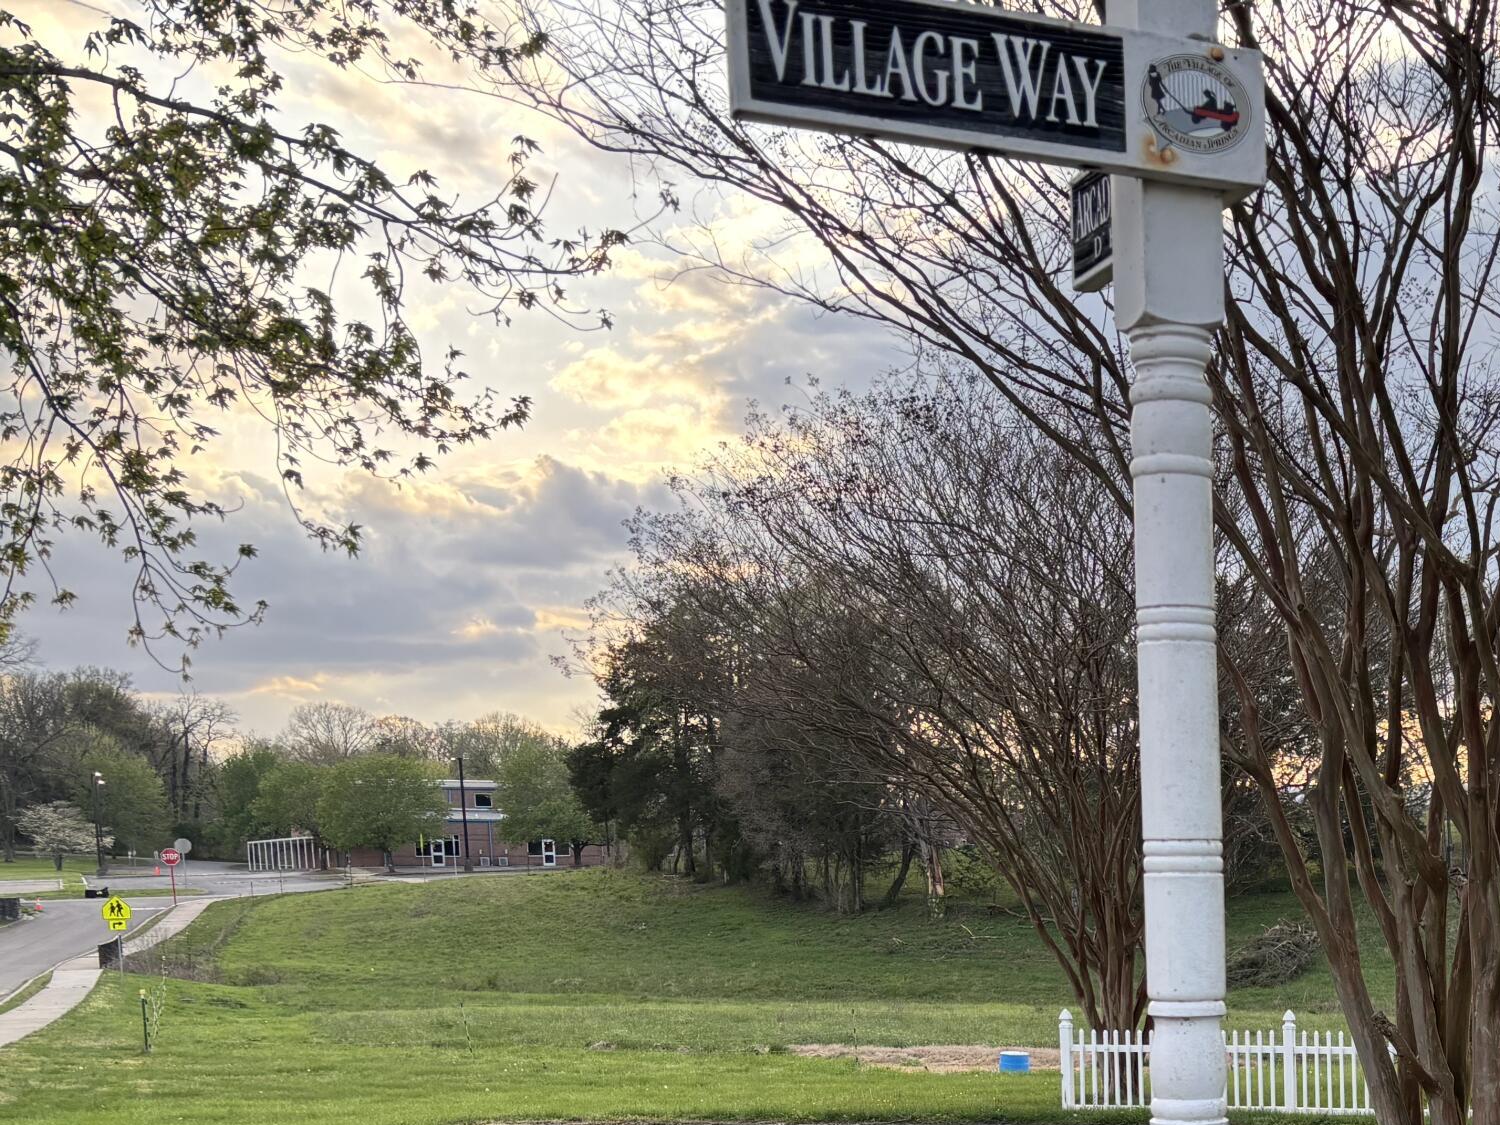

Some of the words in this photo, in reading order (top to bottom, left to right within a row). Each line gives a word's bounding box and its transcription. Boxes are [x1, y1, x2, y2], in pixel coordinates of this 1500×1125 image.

[757, 0, 983, 111] VILLAGE
[990, 33, 1107, 128] WAY
[1076, 176, 1111, 243] ARCAD
